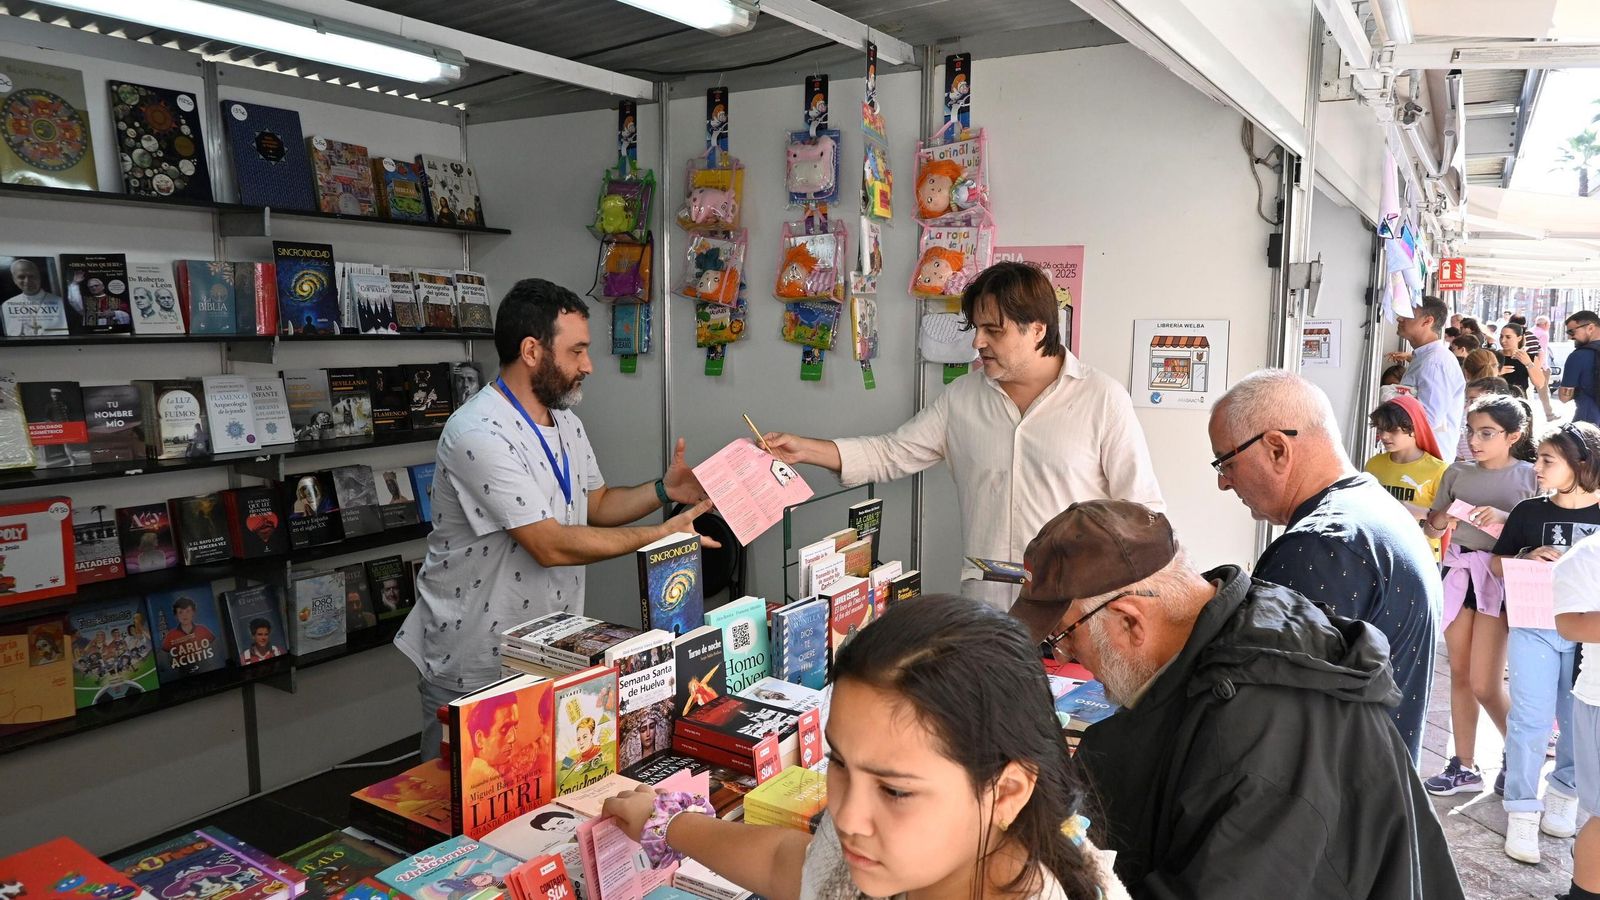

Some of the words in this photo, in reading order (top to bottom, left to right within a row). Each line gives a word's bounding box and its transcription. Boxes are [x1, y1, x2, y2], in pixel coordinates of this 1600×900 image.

[939, 142, 969, 160] orinal
[929, 229, 942, 241] La
[946, 230, 970, 244] ropa
[278, 247, 330, 259] SINCRONICIDAD
[1043, 262, 1052, 270] 26
[1052, 261, 1078, 270] octubre
[1055, 269, 1077, 279] 2025
[40, 305, 59, 314] XIV
[175, 396, 192, 404] LUZ
[210, 393, 248, 401] FLAMENCO
[251, 391, 279, 399] INFANTE
[106, 401, 119, 409] TU
[94, 410, 134, 419] NOMBRE
[164, 410, 197, 418] FUIMOS
[106, 418, 125, 428] MÍO
[649, 541, 699, 565] SINCRONICIDAD
[800, 628, 814, 639] DIOS
[170, 638, 210, 657] CARLO
[688, 646, 702, 660] Turno
[701, 644, 708, 654] de
[707, 639, 722, 652] noche
[171, 647, 214, 669] ACUTIS
[725, 652, 765, 677] Homo
[620, 674, 651, 690] Semana
[652, 665, 673, 679] Santa
[726, 668, 768, 695] Solver
[628, 687, 639, 698] de
[640, 678, 665, 694] Huelva
[1074, 698, 1111, 709] OSHO
[637, 755, 681, 779] SEMANA
[470, 784, 495, 802] Miguel
[471, 776, 542, 829] LITRI
[540, 873, 567, 894] CONTRATA
